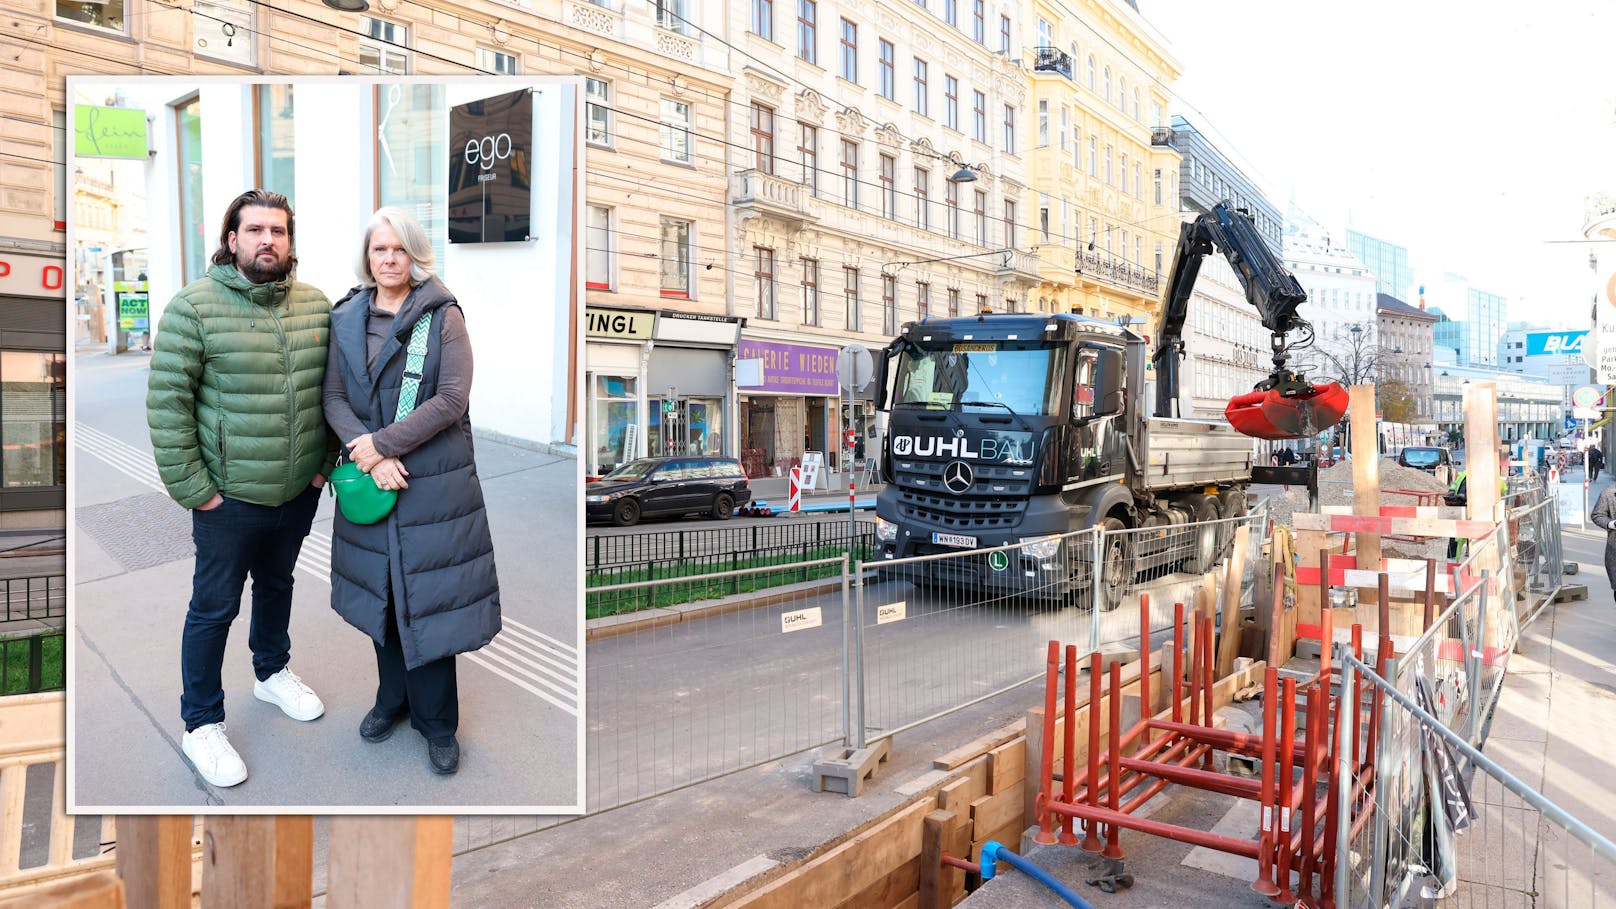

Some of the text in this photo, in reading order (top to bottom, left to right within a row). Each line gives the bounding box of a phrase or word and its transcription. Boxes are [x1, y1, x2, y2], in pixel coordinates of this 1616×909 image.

[465, 133, 512, 170] ego
[121, 299, 147, 307] ACT
[799, 353, 835, 374] WIEDEN
[1080, 447, 1097, 458] UHL
